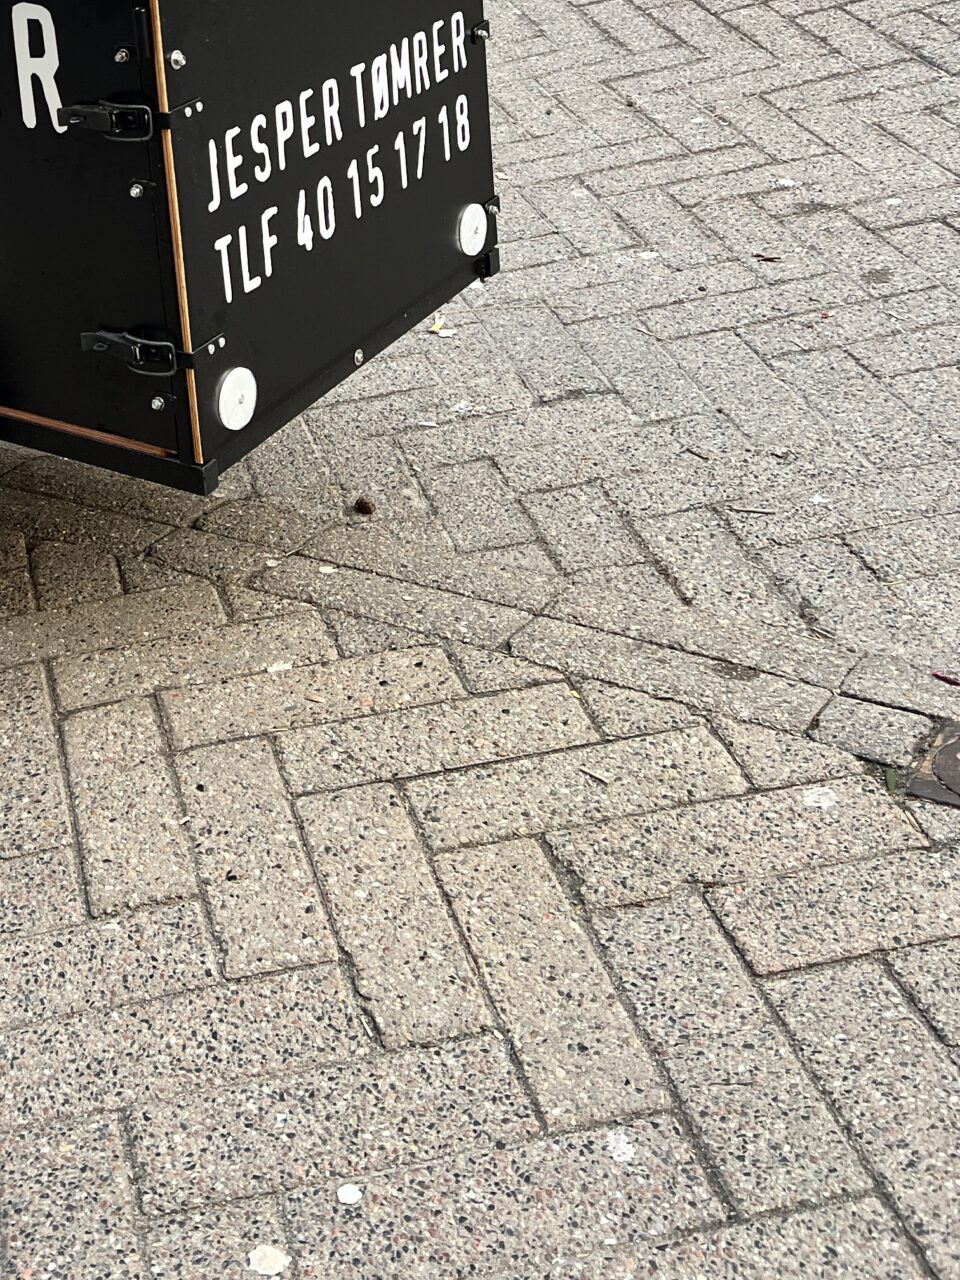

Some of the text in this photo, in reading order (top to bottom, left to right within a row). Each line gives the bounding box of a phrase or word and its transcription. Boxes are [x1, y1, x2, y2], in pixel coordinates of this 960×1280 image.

[208, 10, 468, 213] JESPER TØMRER
[214, 94, 471, 304] TLF 40 15 17 18
